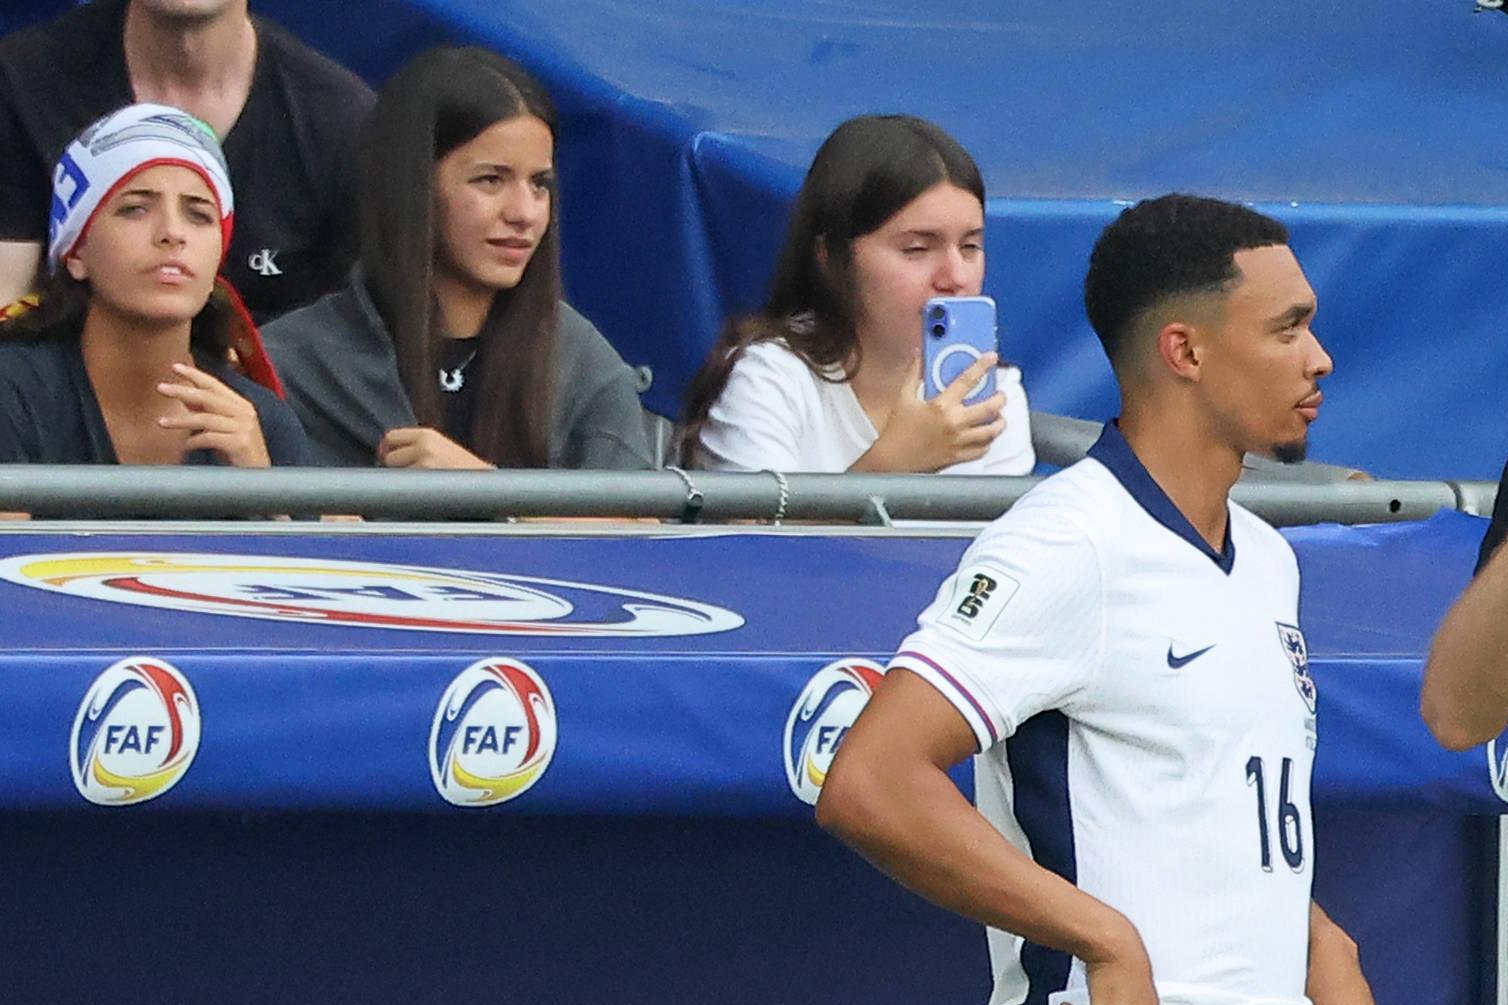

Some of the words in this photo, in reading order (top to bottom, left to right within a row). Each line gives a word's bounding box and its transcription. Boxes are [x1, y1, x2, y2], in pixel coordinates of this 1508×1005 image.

[104, 725, 166, 755] FAF
[462, 725, 523, 755] FAF
[1246, 756, 1305, 874] 16
